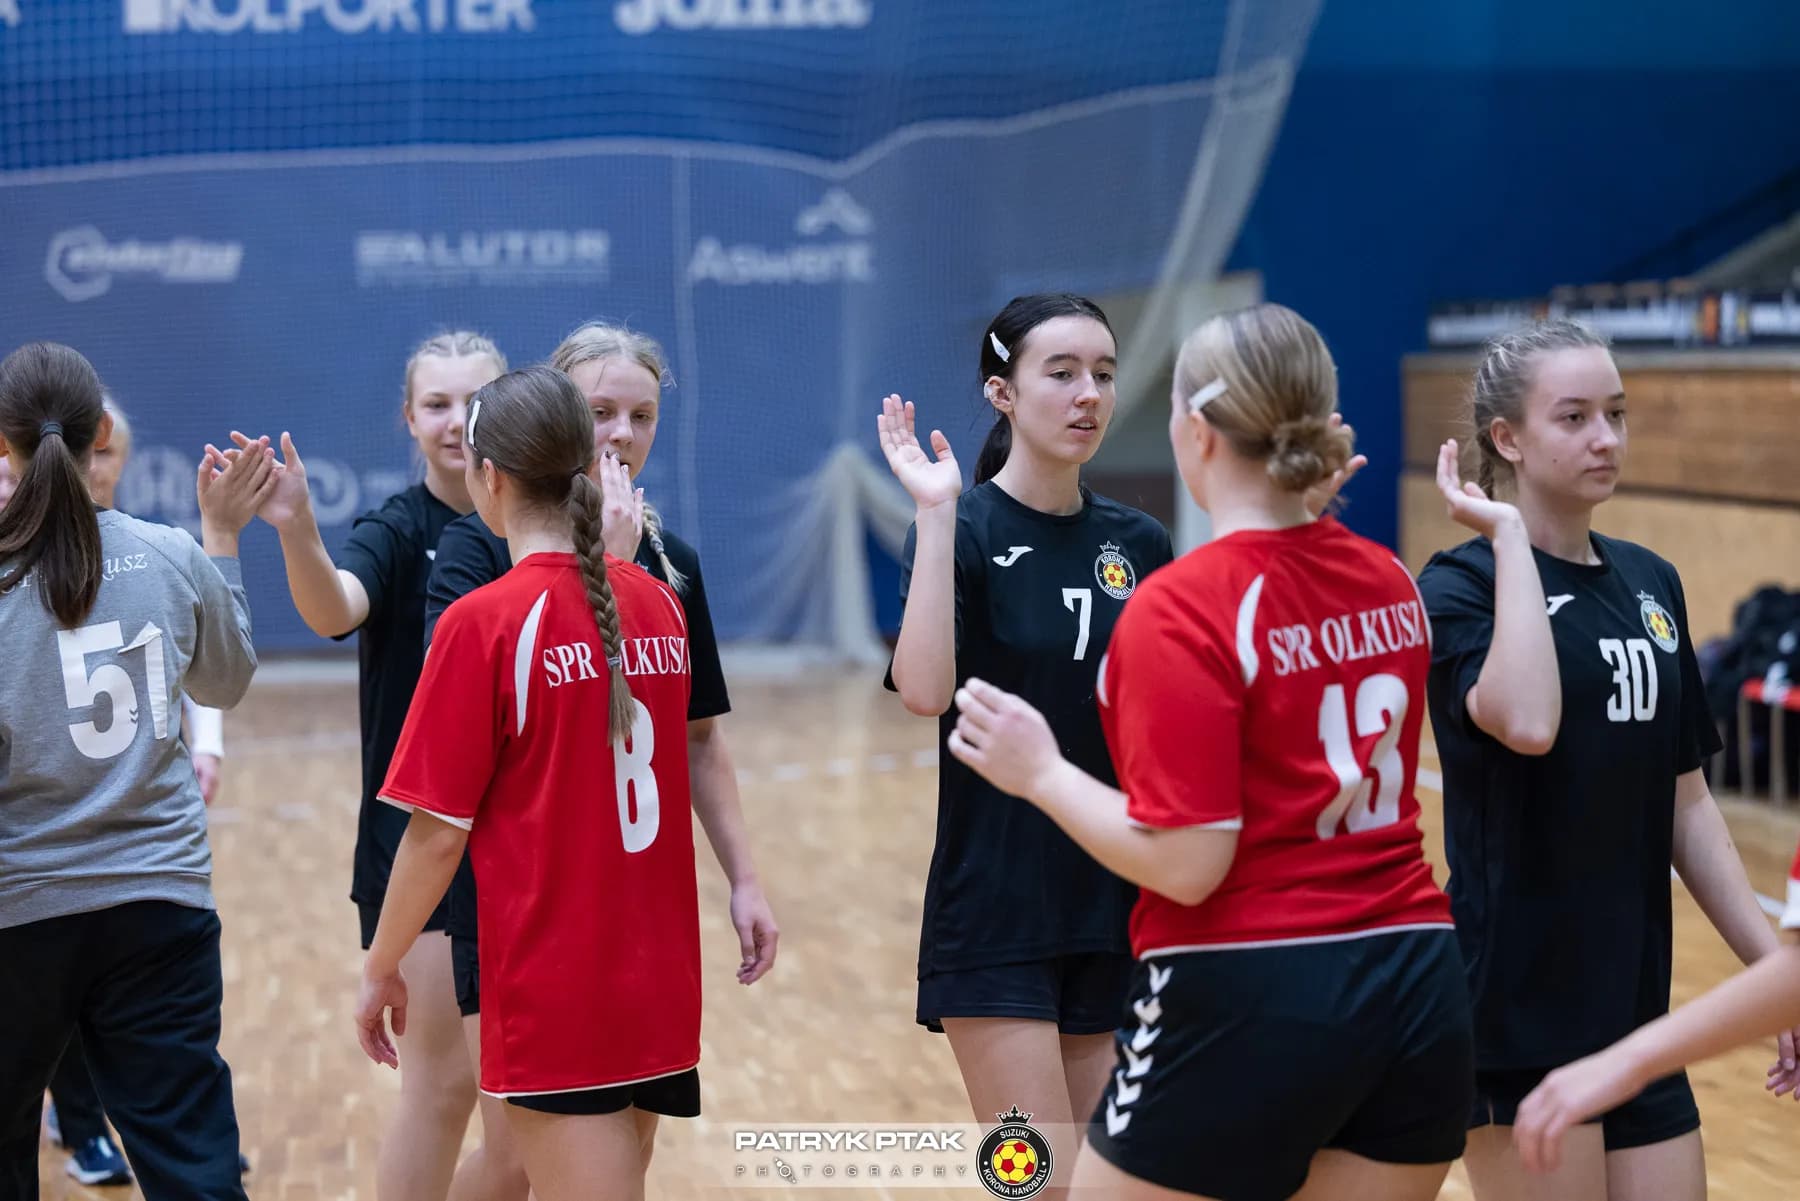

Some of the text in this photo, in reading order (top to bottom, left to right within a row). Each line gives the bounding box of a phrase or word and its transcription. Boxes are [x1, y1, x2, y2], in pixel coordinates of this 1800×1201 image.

[543, 635, 687, 688] SPR LKUSZ
[1062, 588, 1092, 660] 7
[1268, 600, 1425, 676] SPR OLKUSZ
[57, 620, 168, 759] 51
[1598, 638, 1658, 722] 30
[1315, 673, 1409, 841] 13
